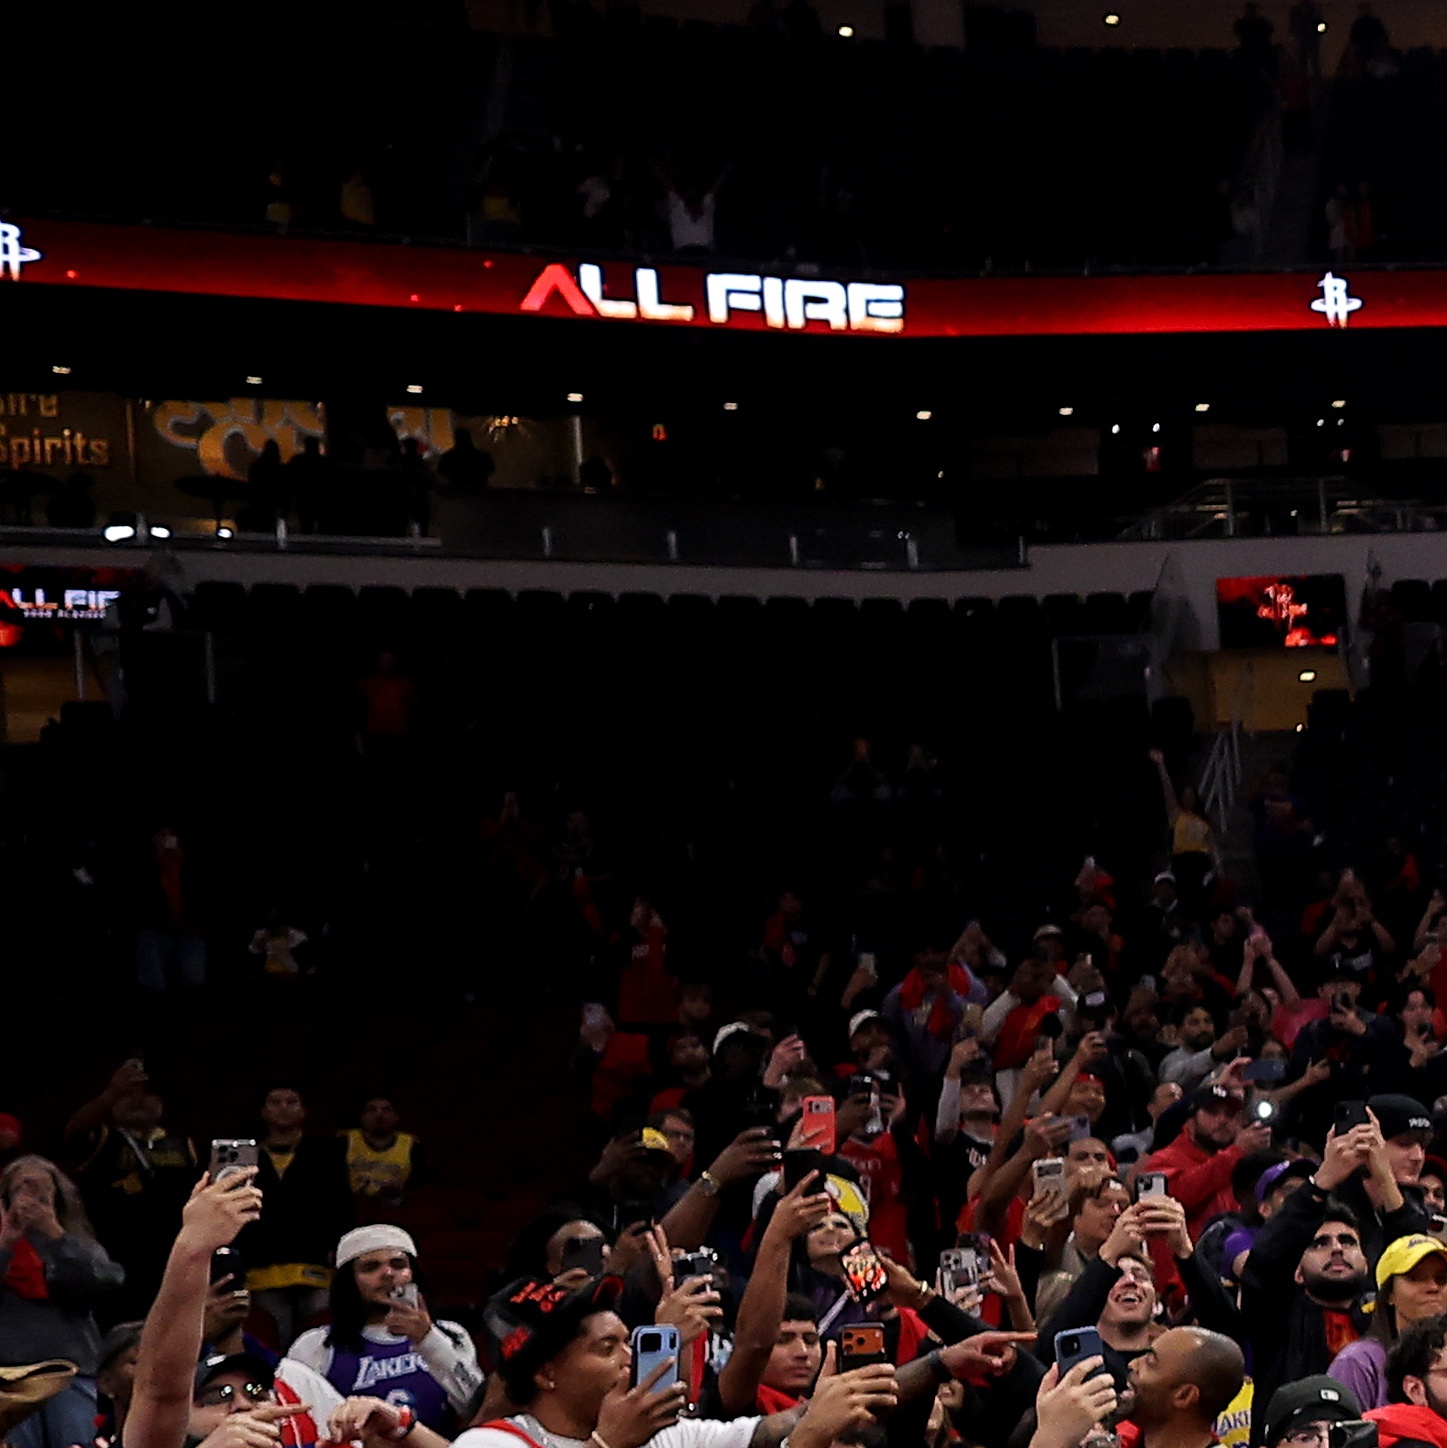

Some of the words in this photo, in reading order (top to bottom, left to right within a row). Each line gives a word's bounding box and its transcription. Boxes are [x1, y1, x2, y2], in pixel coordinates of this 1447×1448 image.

[520, 263, 695, 321] ALL
[706, 273, 904, 333] FIRE
[352, 1352, 428, 1391] LAKER
